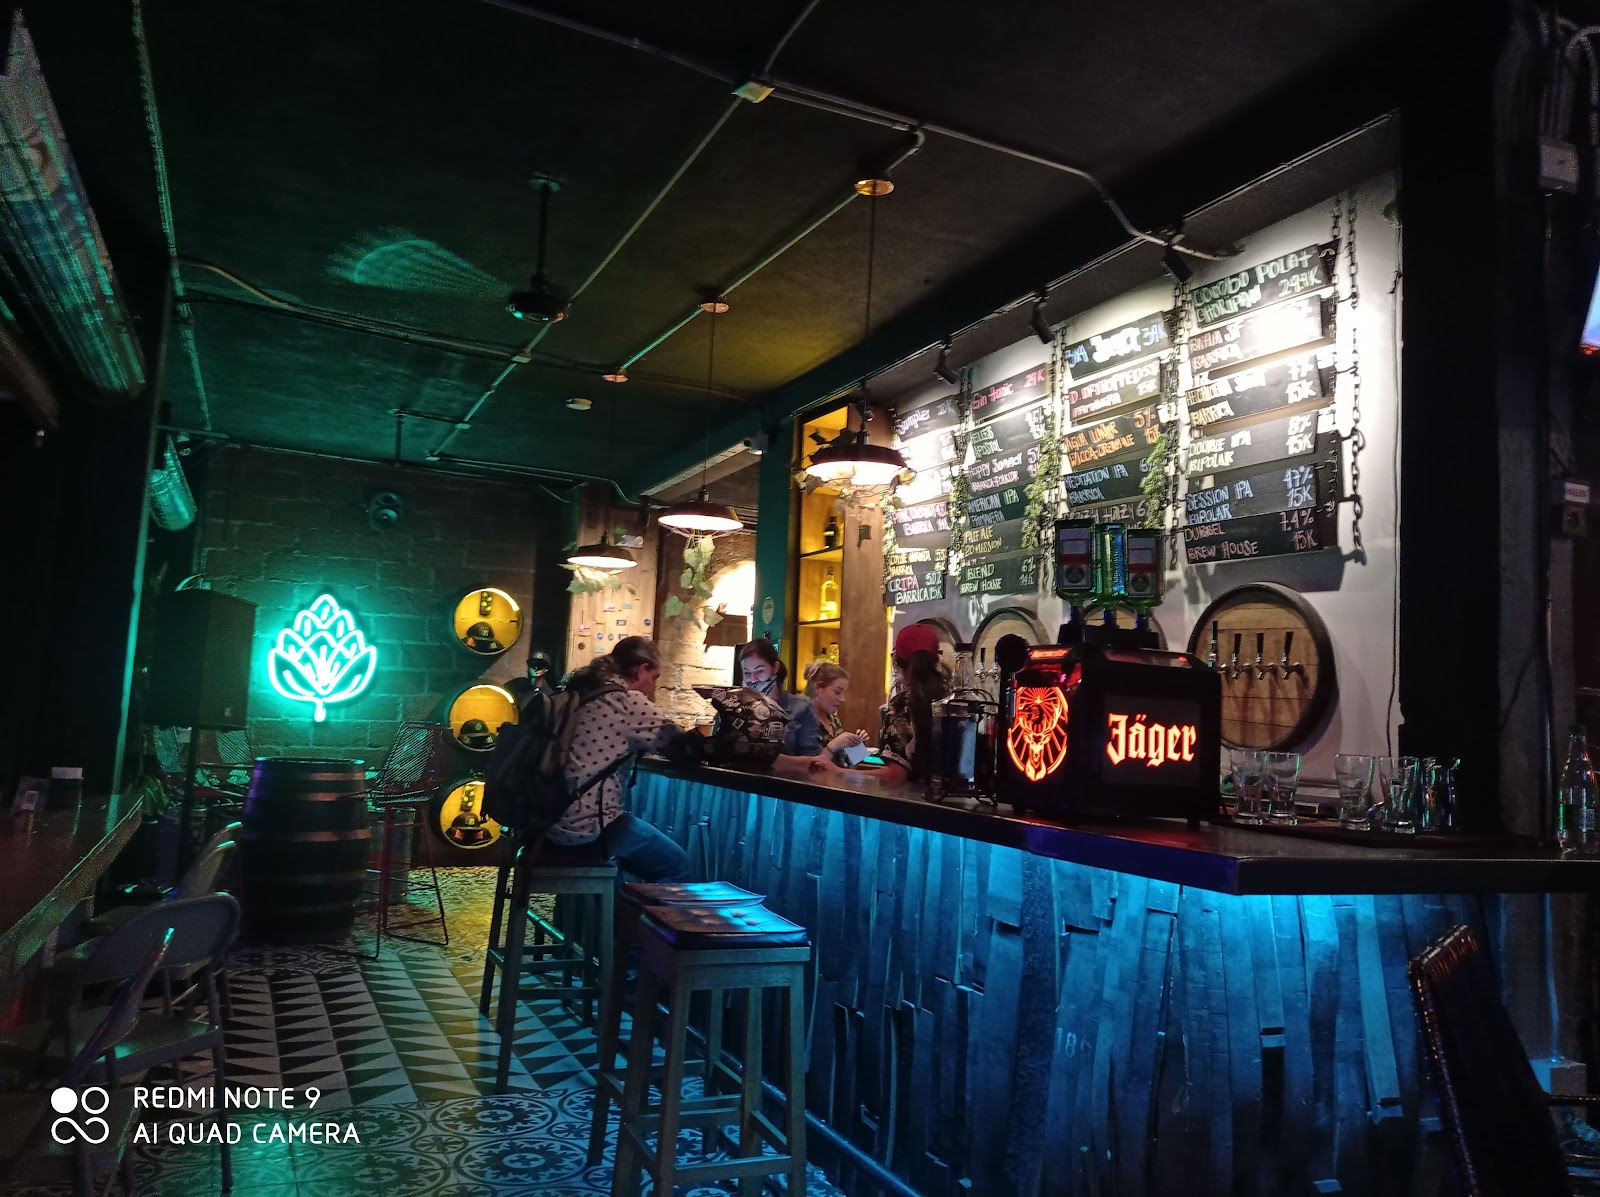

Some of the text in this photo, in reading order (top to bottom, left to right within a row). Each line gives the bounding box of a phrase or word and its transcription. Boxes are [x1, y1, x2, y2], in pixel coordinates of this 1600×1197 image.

[1113, 463, 1129, 480] IPA
[1003, 488, 1020, 505] IPA
[1186, 485, 1230, 512] SESSION
[1233, 479, 1254, 500] IPA
[1188, 484, 1314, 525] BIPOLAR 15K
[1187, 529, 1318, 561] BREW HOUSE 15K
[967, 563, 995, 582] BLEND
[894, 587, 929, 605] BARRICA
[961, 580, 979, 594] BREW
[1106, 713, 1197, 768] Jäger
